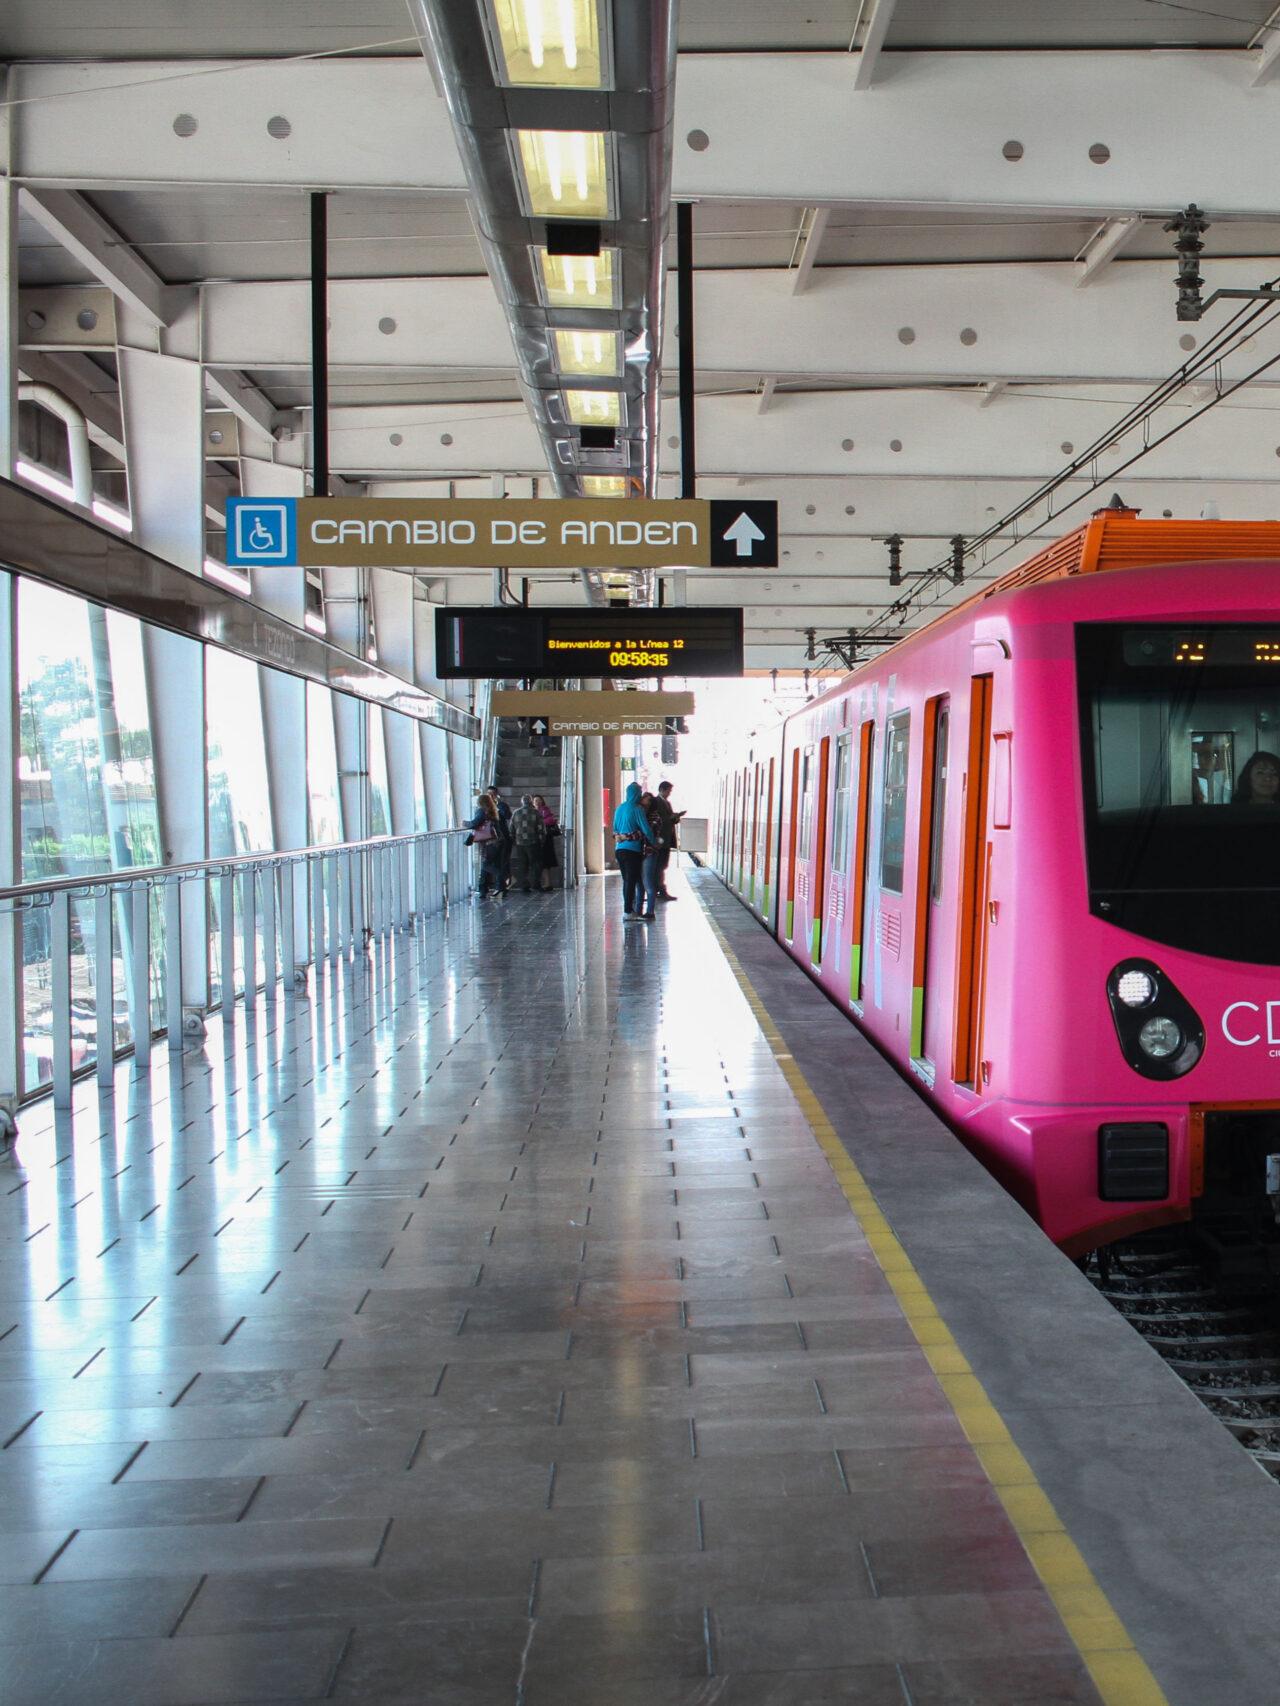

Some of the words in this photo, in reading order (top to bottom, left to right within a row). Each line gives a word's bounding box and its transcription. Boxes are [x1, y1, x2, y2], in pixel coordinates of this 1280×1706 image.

[310, 519, 476, 545] CAMBIO
[490, 520, 547, 545] DE
[560, 520, 698, 546] ANDEN
[548, 639, 611, 649] Bienvenidos
[614, 640, 622, 649] a
[625, 640, 637, 649] la
[673, 639, 685, 649] 12
[609, 651, 669, 667] 09:58:35
[552, 721, 600, 731] CAMBIO
[603, 721, 620, 731] DE
[622, 721, 663, 730] ANDEN
